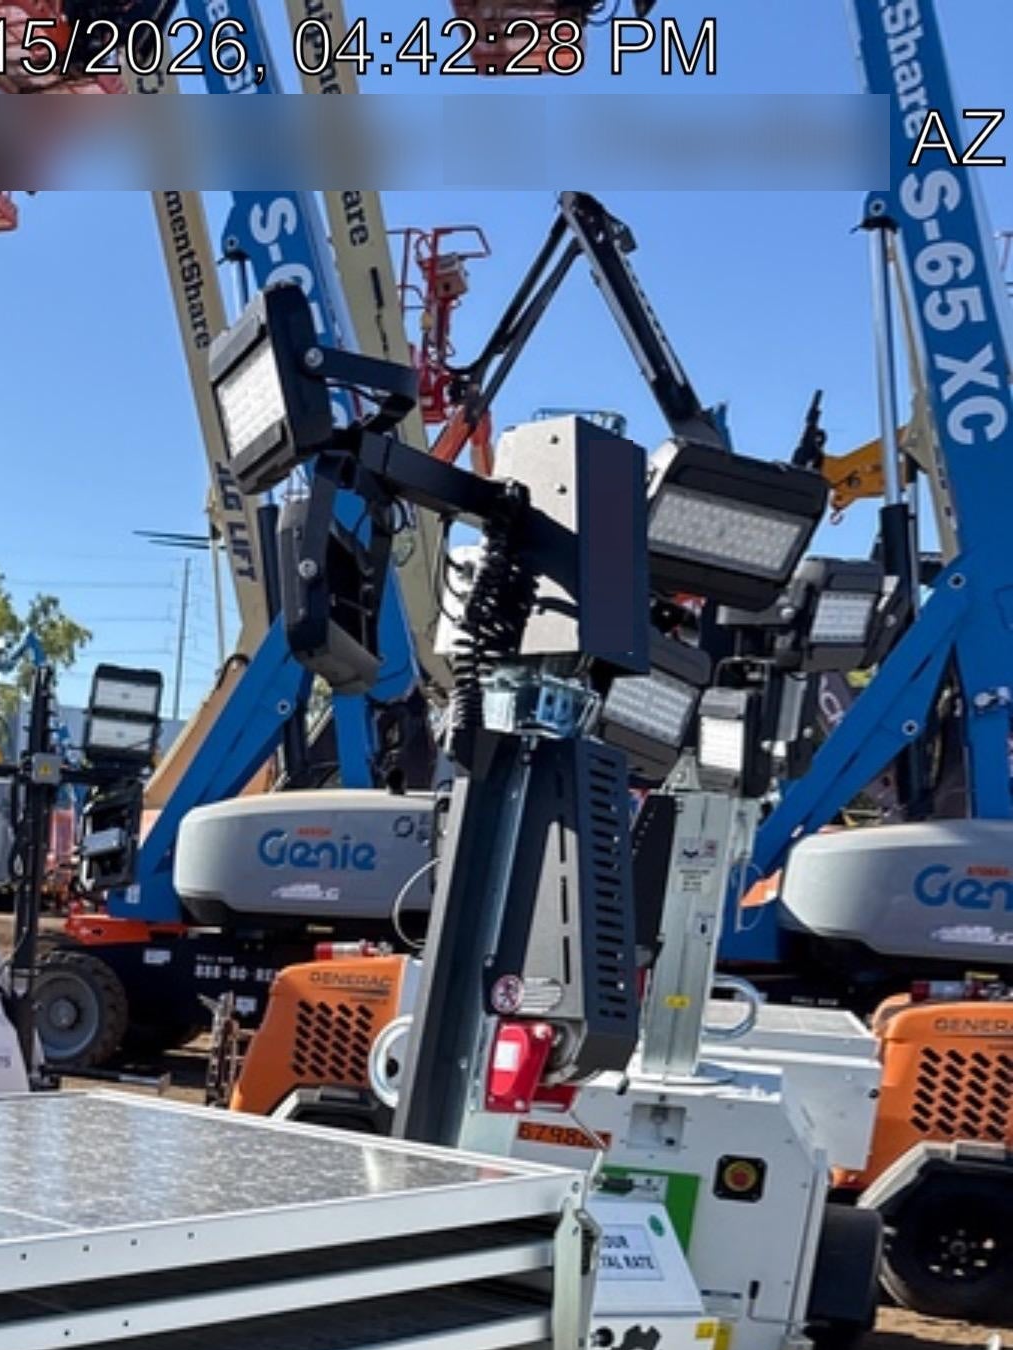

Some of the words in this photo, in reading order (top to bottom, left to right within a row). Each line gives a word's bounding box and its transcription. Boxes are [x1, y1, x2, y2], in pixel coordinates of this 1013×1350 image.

[899, 169, 986, 331] S-65
[934, 342, 1008, 445] XC
[227, 521, 257, 582] LIFT
[258, 828, 376, 871] Genie
